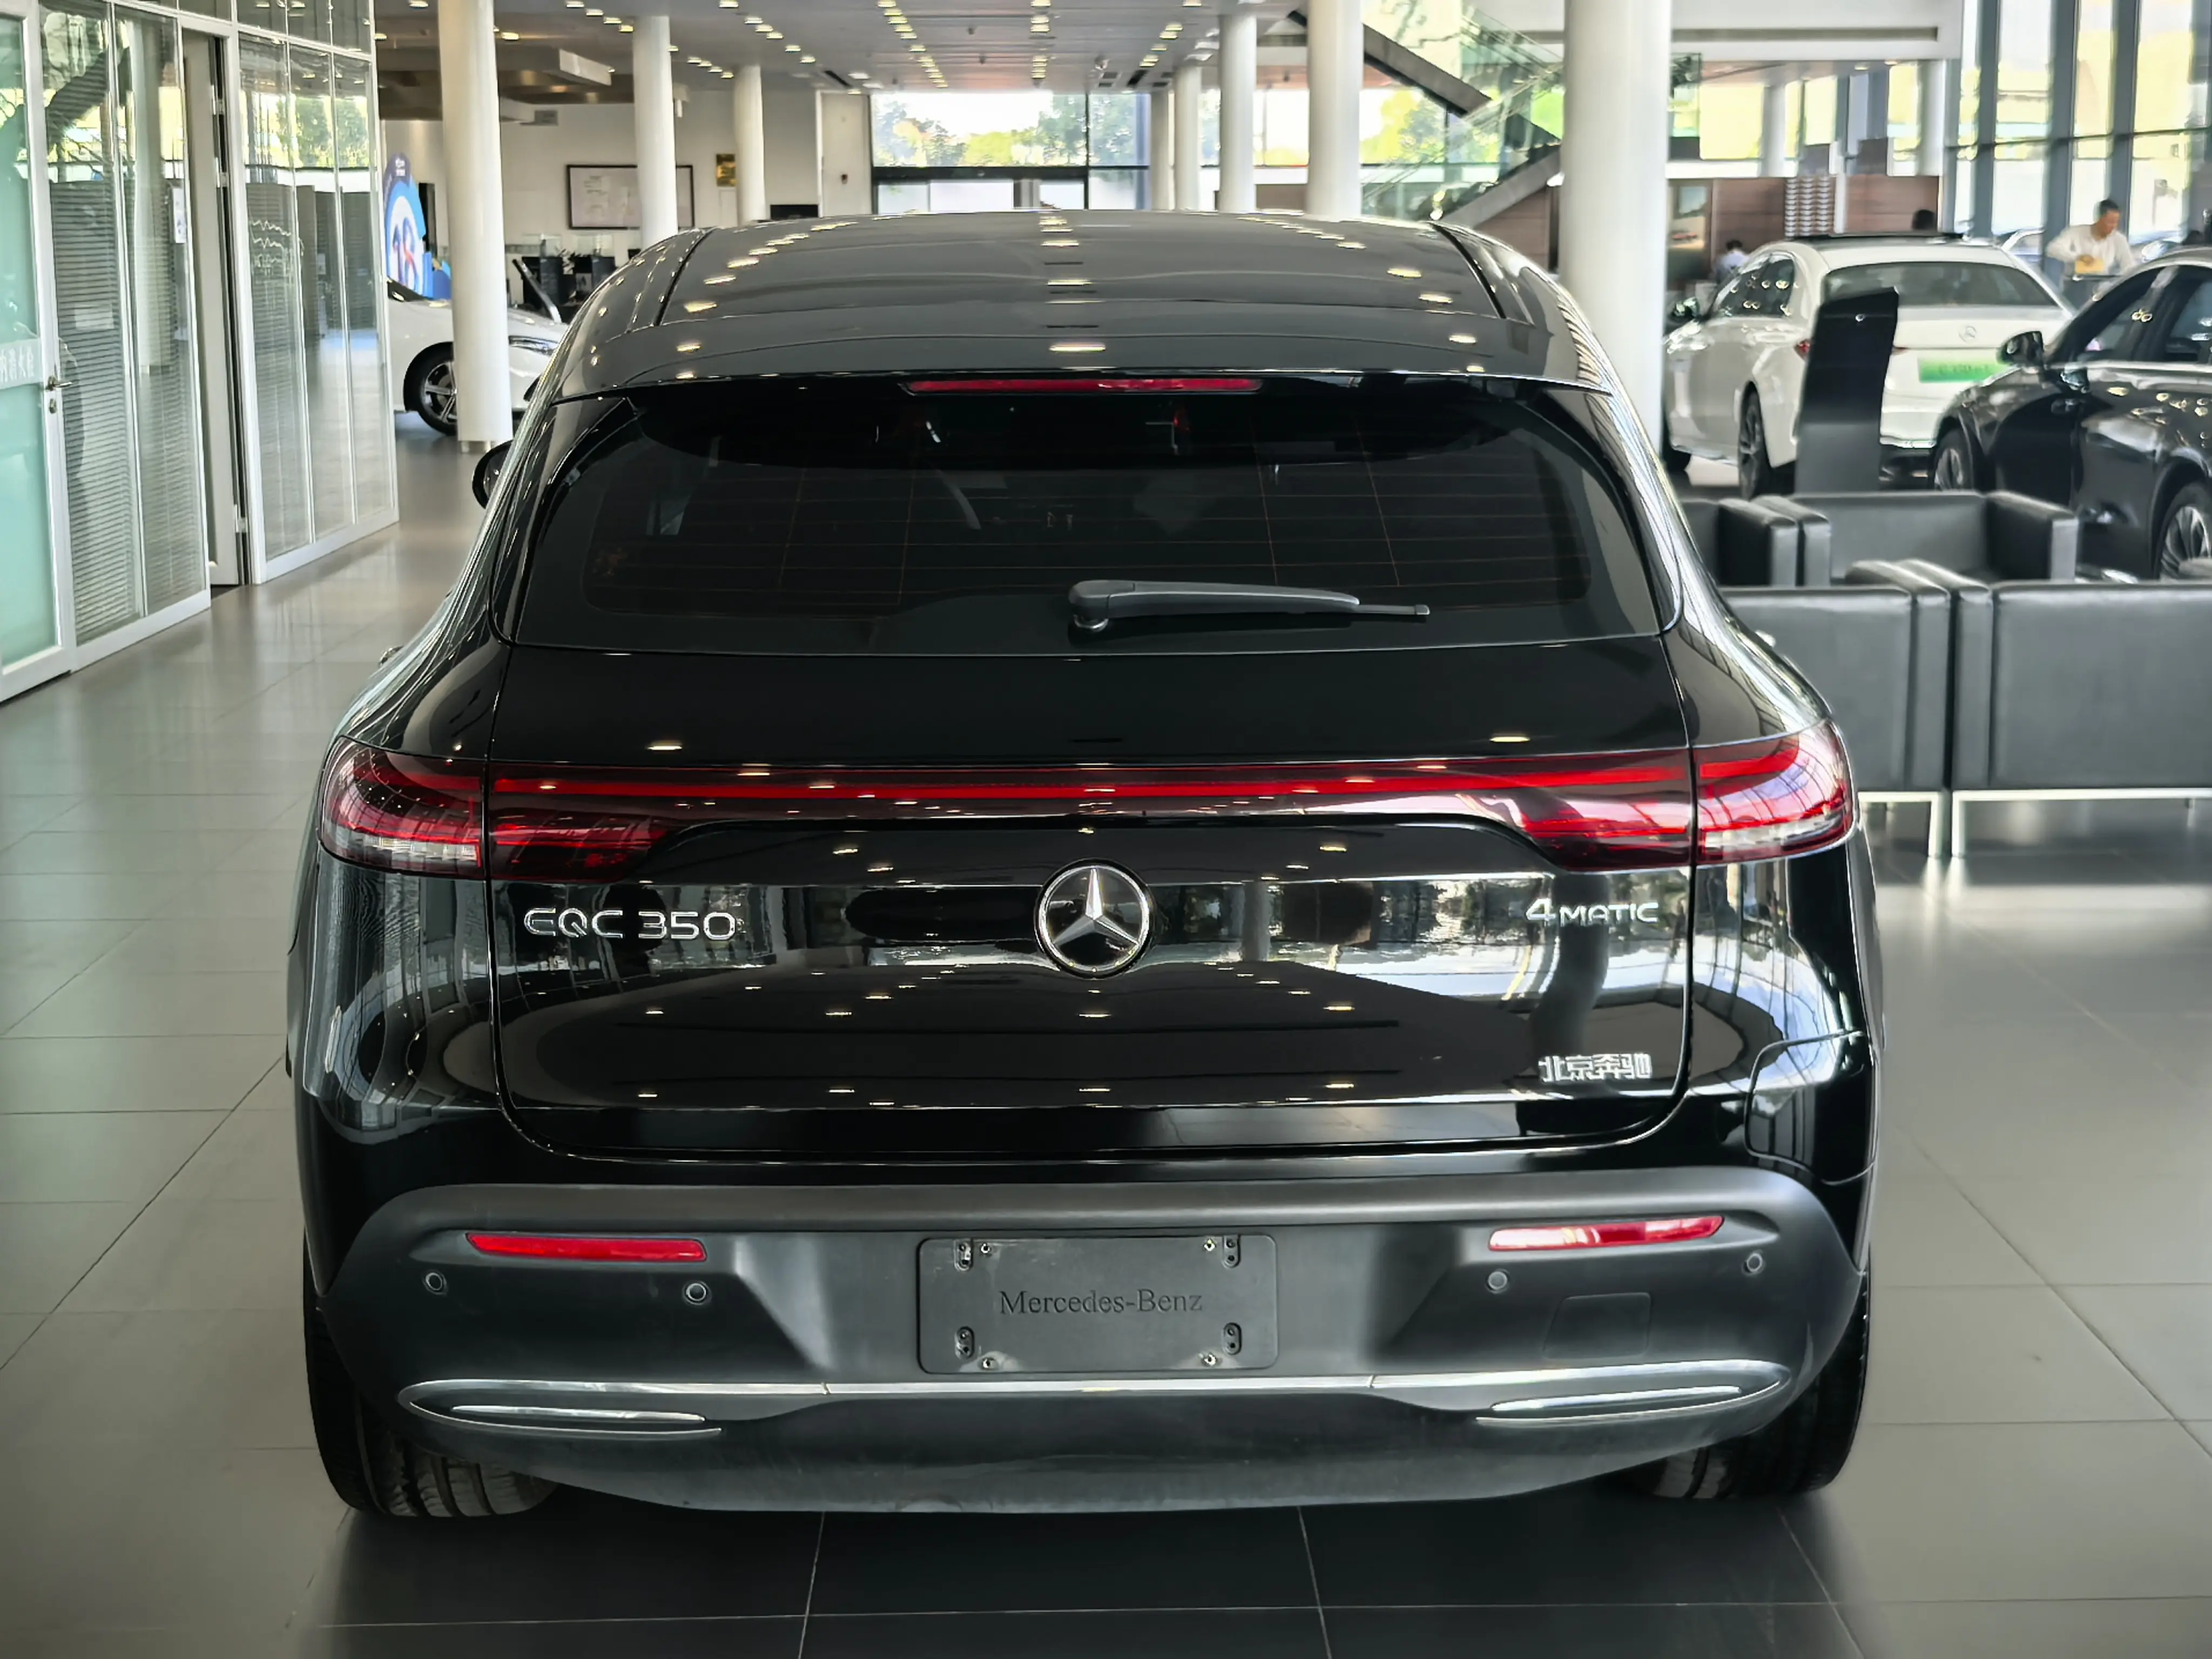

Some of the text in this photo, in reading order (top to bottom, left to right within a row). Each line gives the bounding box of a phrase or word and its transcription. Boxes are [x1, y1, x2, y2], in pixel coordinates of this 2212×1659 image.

[524, 908, 736, 940] EQC 350
[1526, 898, 1658, 927] 4MATIC
[1538, 1053, 1653, 1082] 北京奔驰
[999, 1289, 1202, 1314] Mercedes-Benz
